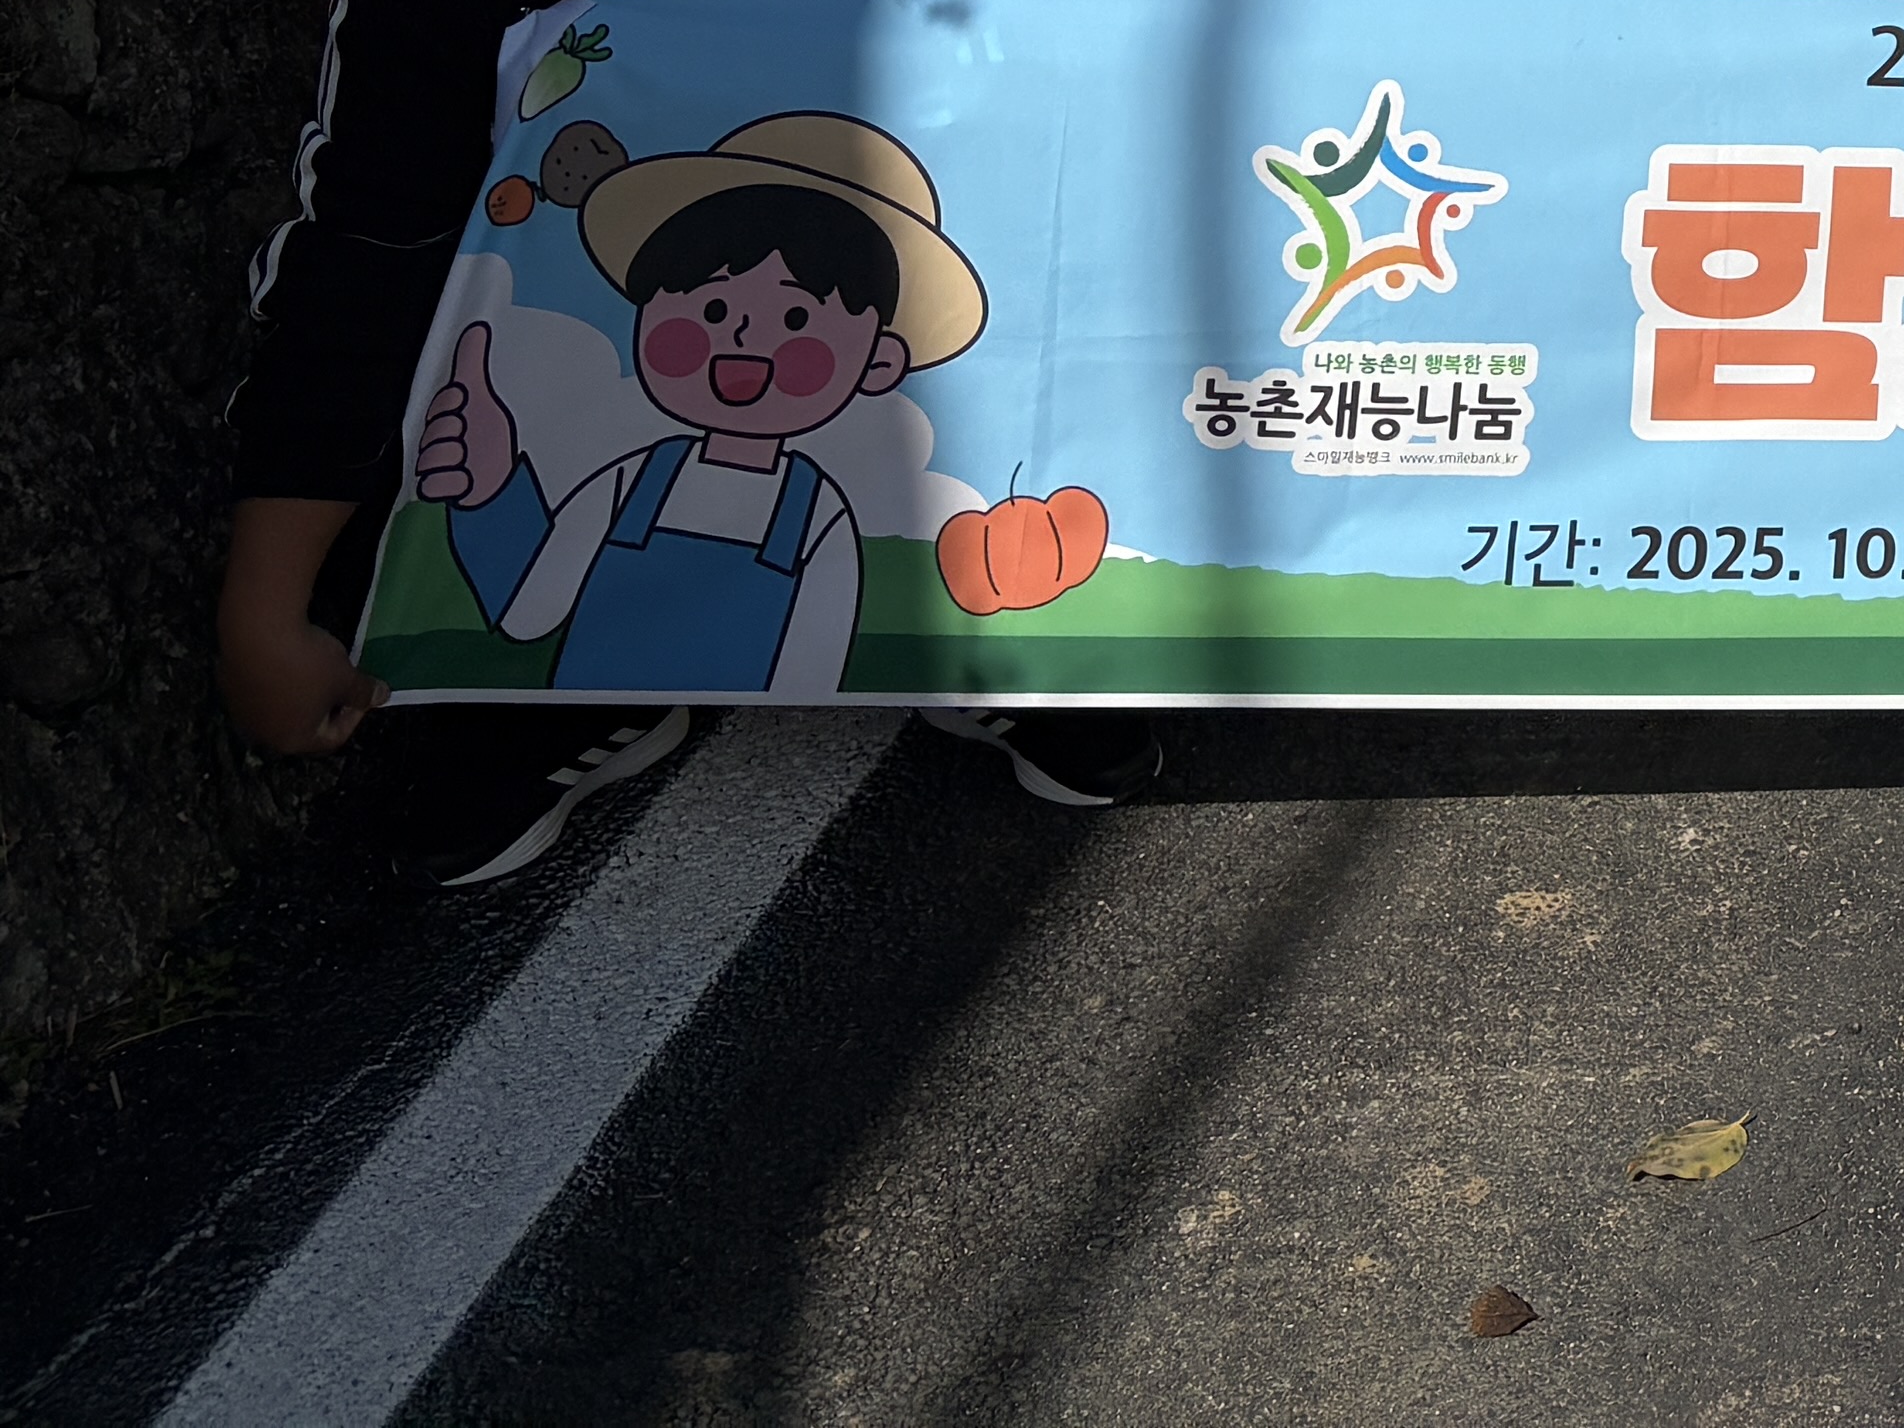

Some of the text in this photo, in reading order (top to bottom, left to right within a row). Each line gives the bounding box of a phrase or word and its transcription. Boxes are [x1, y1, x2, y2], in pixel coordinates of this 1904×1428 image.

[1314, 352, 1527, 377] 나와 농촌의 행복한 동행
[1195, 377, 1523, 442] 농촌재능나눔
[1399, 450, 1519, 466] www.smilebank.kr
[1460, 518, 1602, 588] 기간:
[1625, 524, 1801, 582] 2025.
